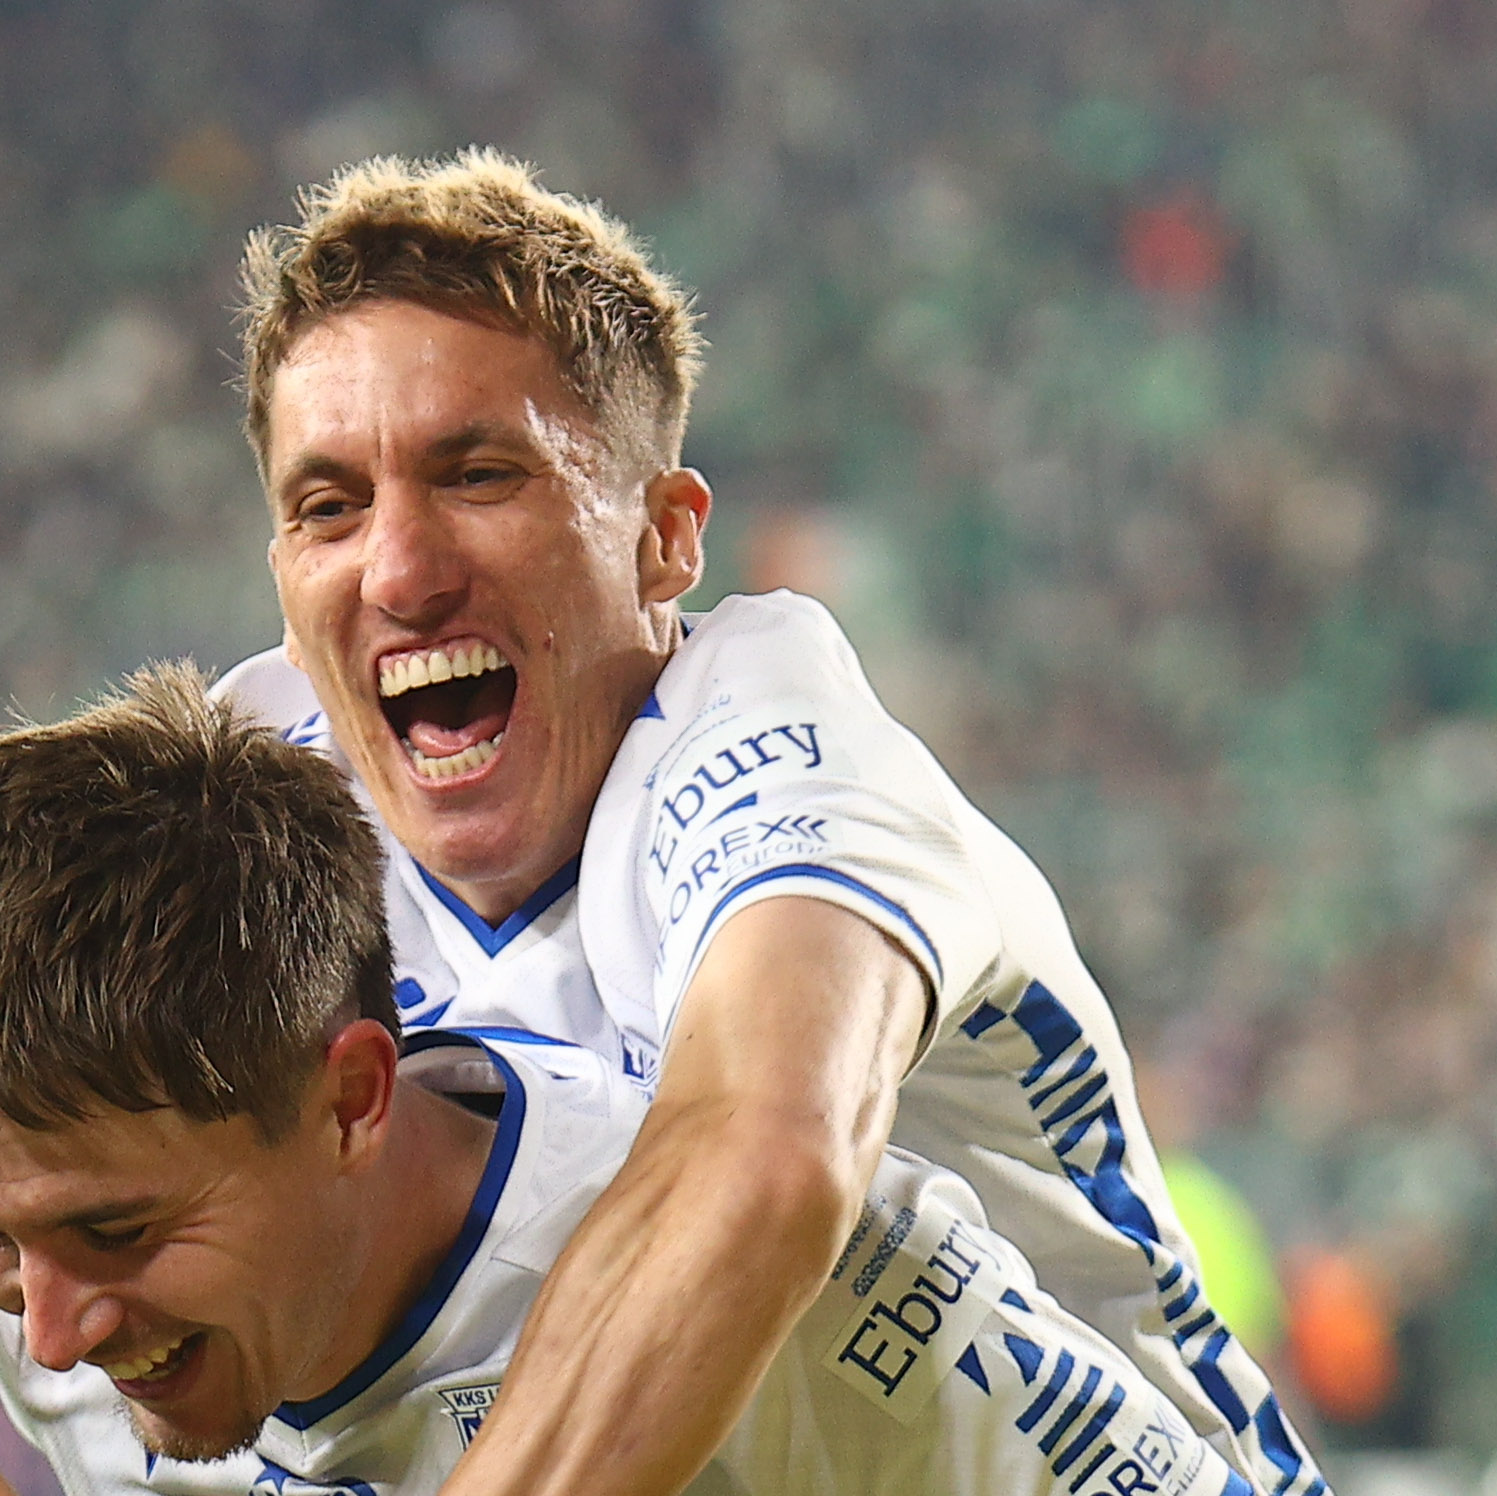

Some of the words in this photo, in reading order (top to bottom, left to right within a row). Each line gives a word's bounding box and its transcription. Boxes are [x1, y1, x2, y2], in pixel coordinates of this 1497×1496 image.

[648, 722, 822, 884] Ebury
[837, 1218, 1003, 1398] Ebury
[452, 1390, 487, 1407] KKS
